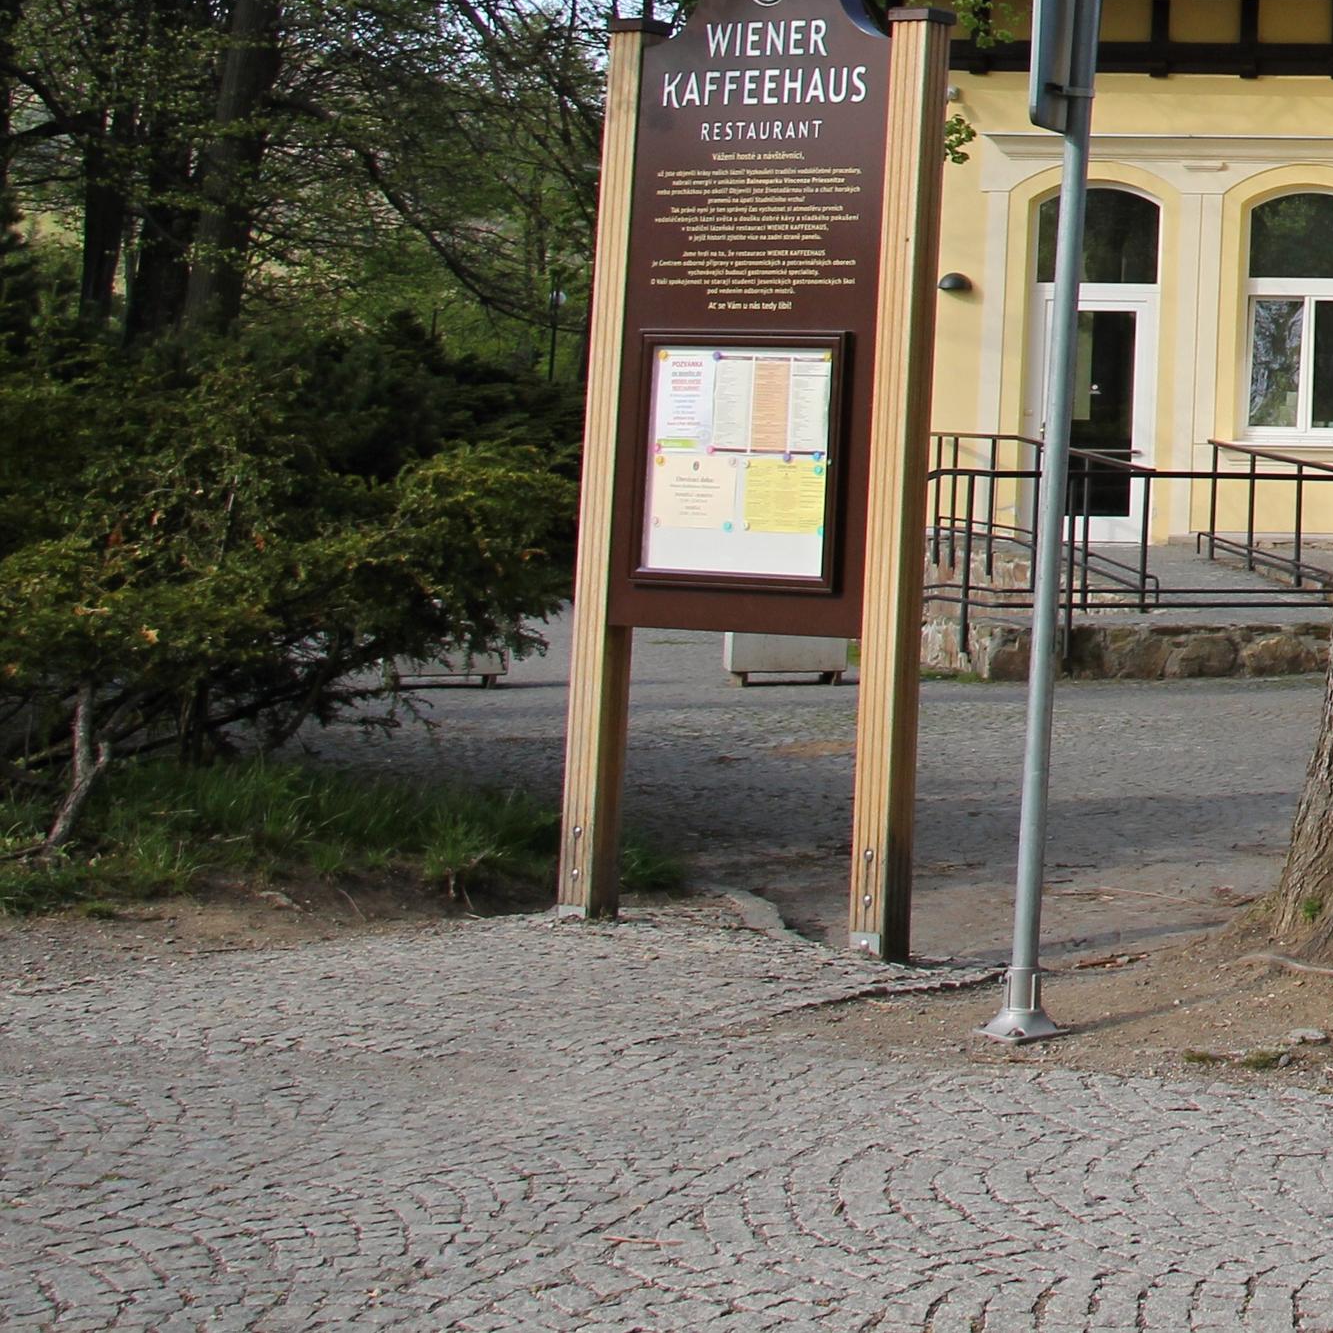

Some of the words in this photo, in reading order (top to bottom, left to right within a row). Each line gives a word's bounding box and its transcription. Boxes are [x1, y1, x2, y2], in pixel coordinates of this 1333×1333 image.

[706, 19, 828, 58] WIENER
[662, 66, 867, 108] KAFFEEHAUS
[700, 120, 822, 141] RESTAURANT
